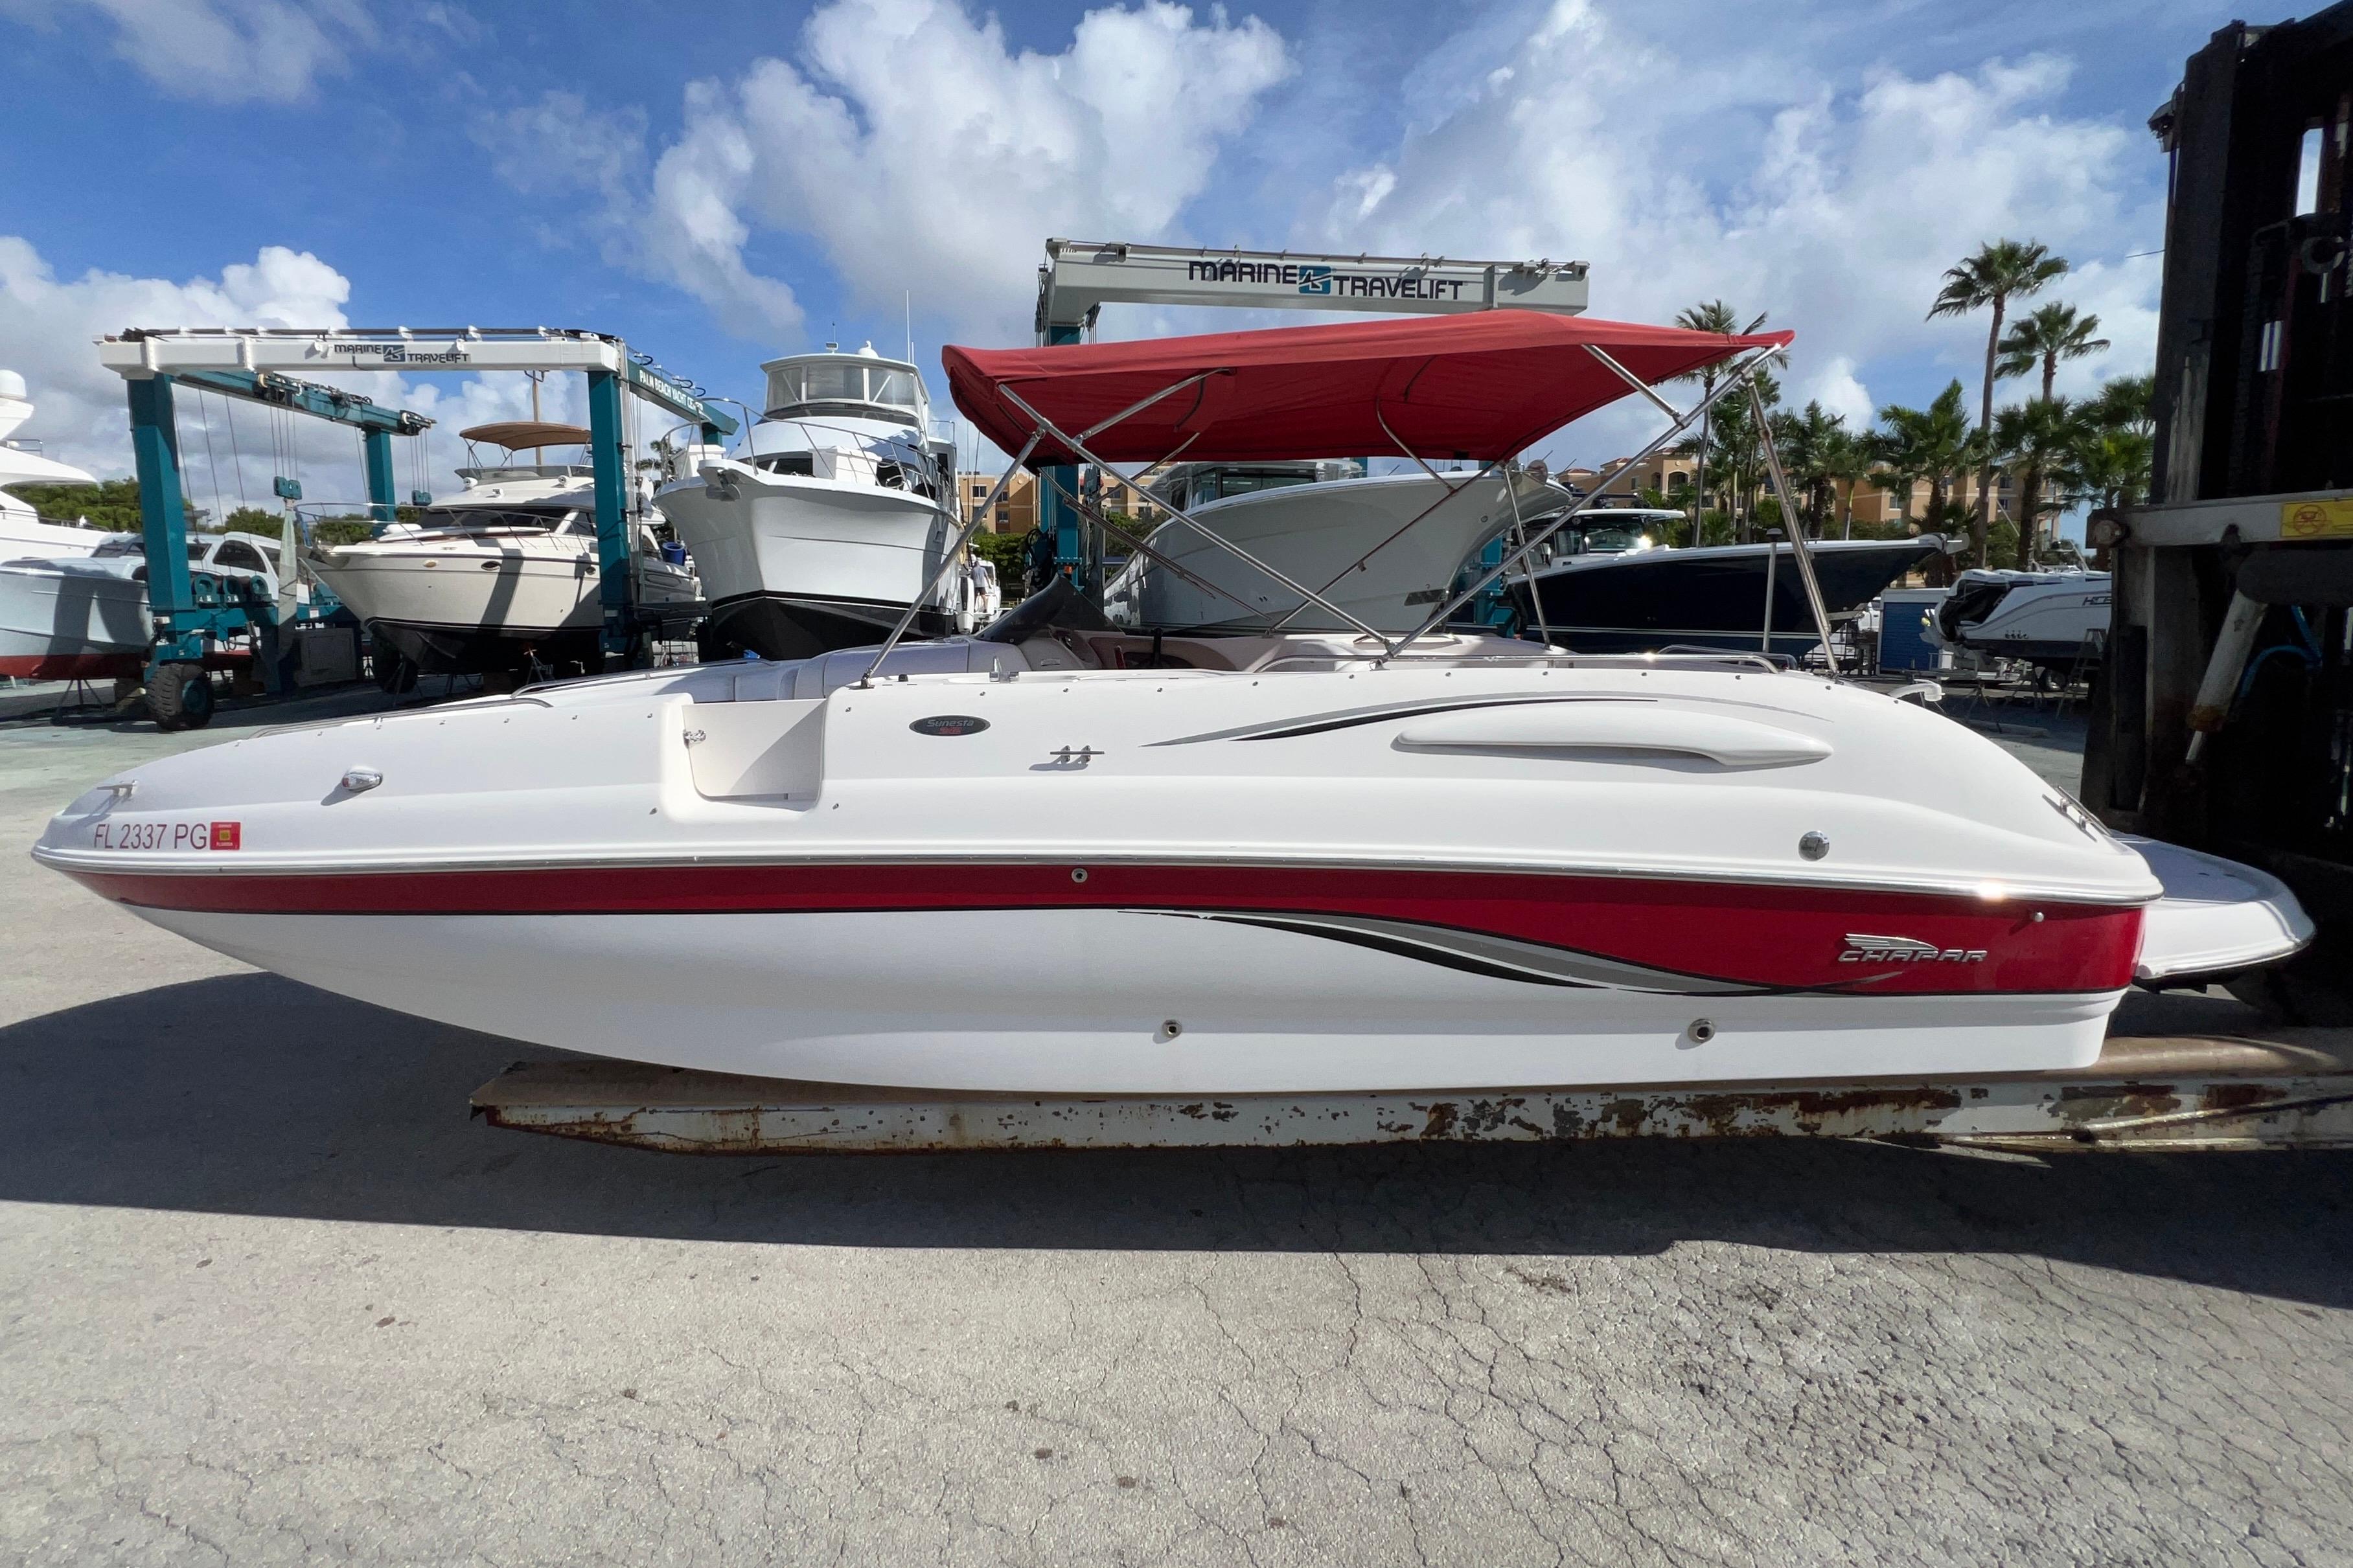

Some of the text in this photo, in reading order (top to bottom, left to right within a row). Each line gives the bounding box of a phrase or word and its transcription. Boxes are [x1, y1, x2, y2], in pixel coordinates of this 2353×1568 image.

[1188, 261, 1463, 300] MARINE TRAVELIFT
[334, 344, 469, 363] MARINE TRAVELIFT
[639, 369, 704, 414] PALM BEACH YACHT CEN
[926, 719, 975, 727] Sunesta
[94, 823, 113, 849] FL
[119, 823, 167, 849] 2337
[174, 823, 207, 850] PG
